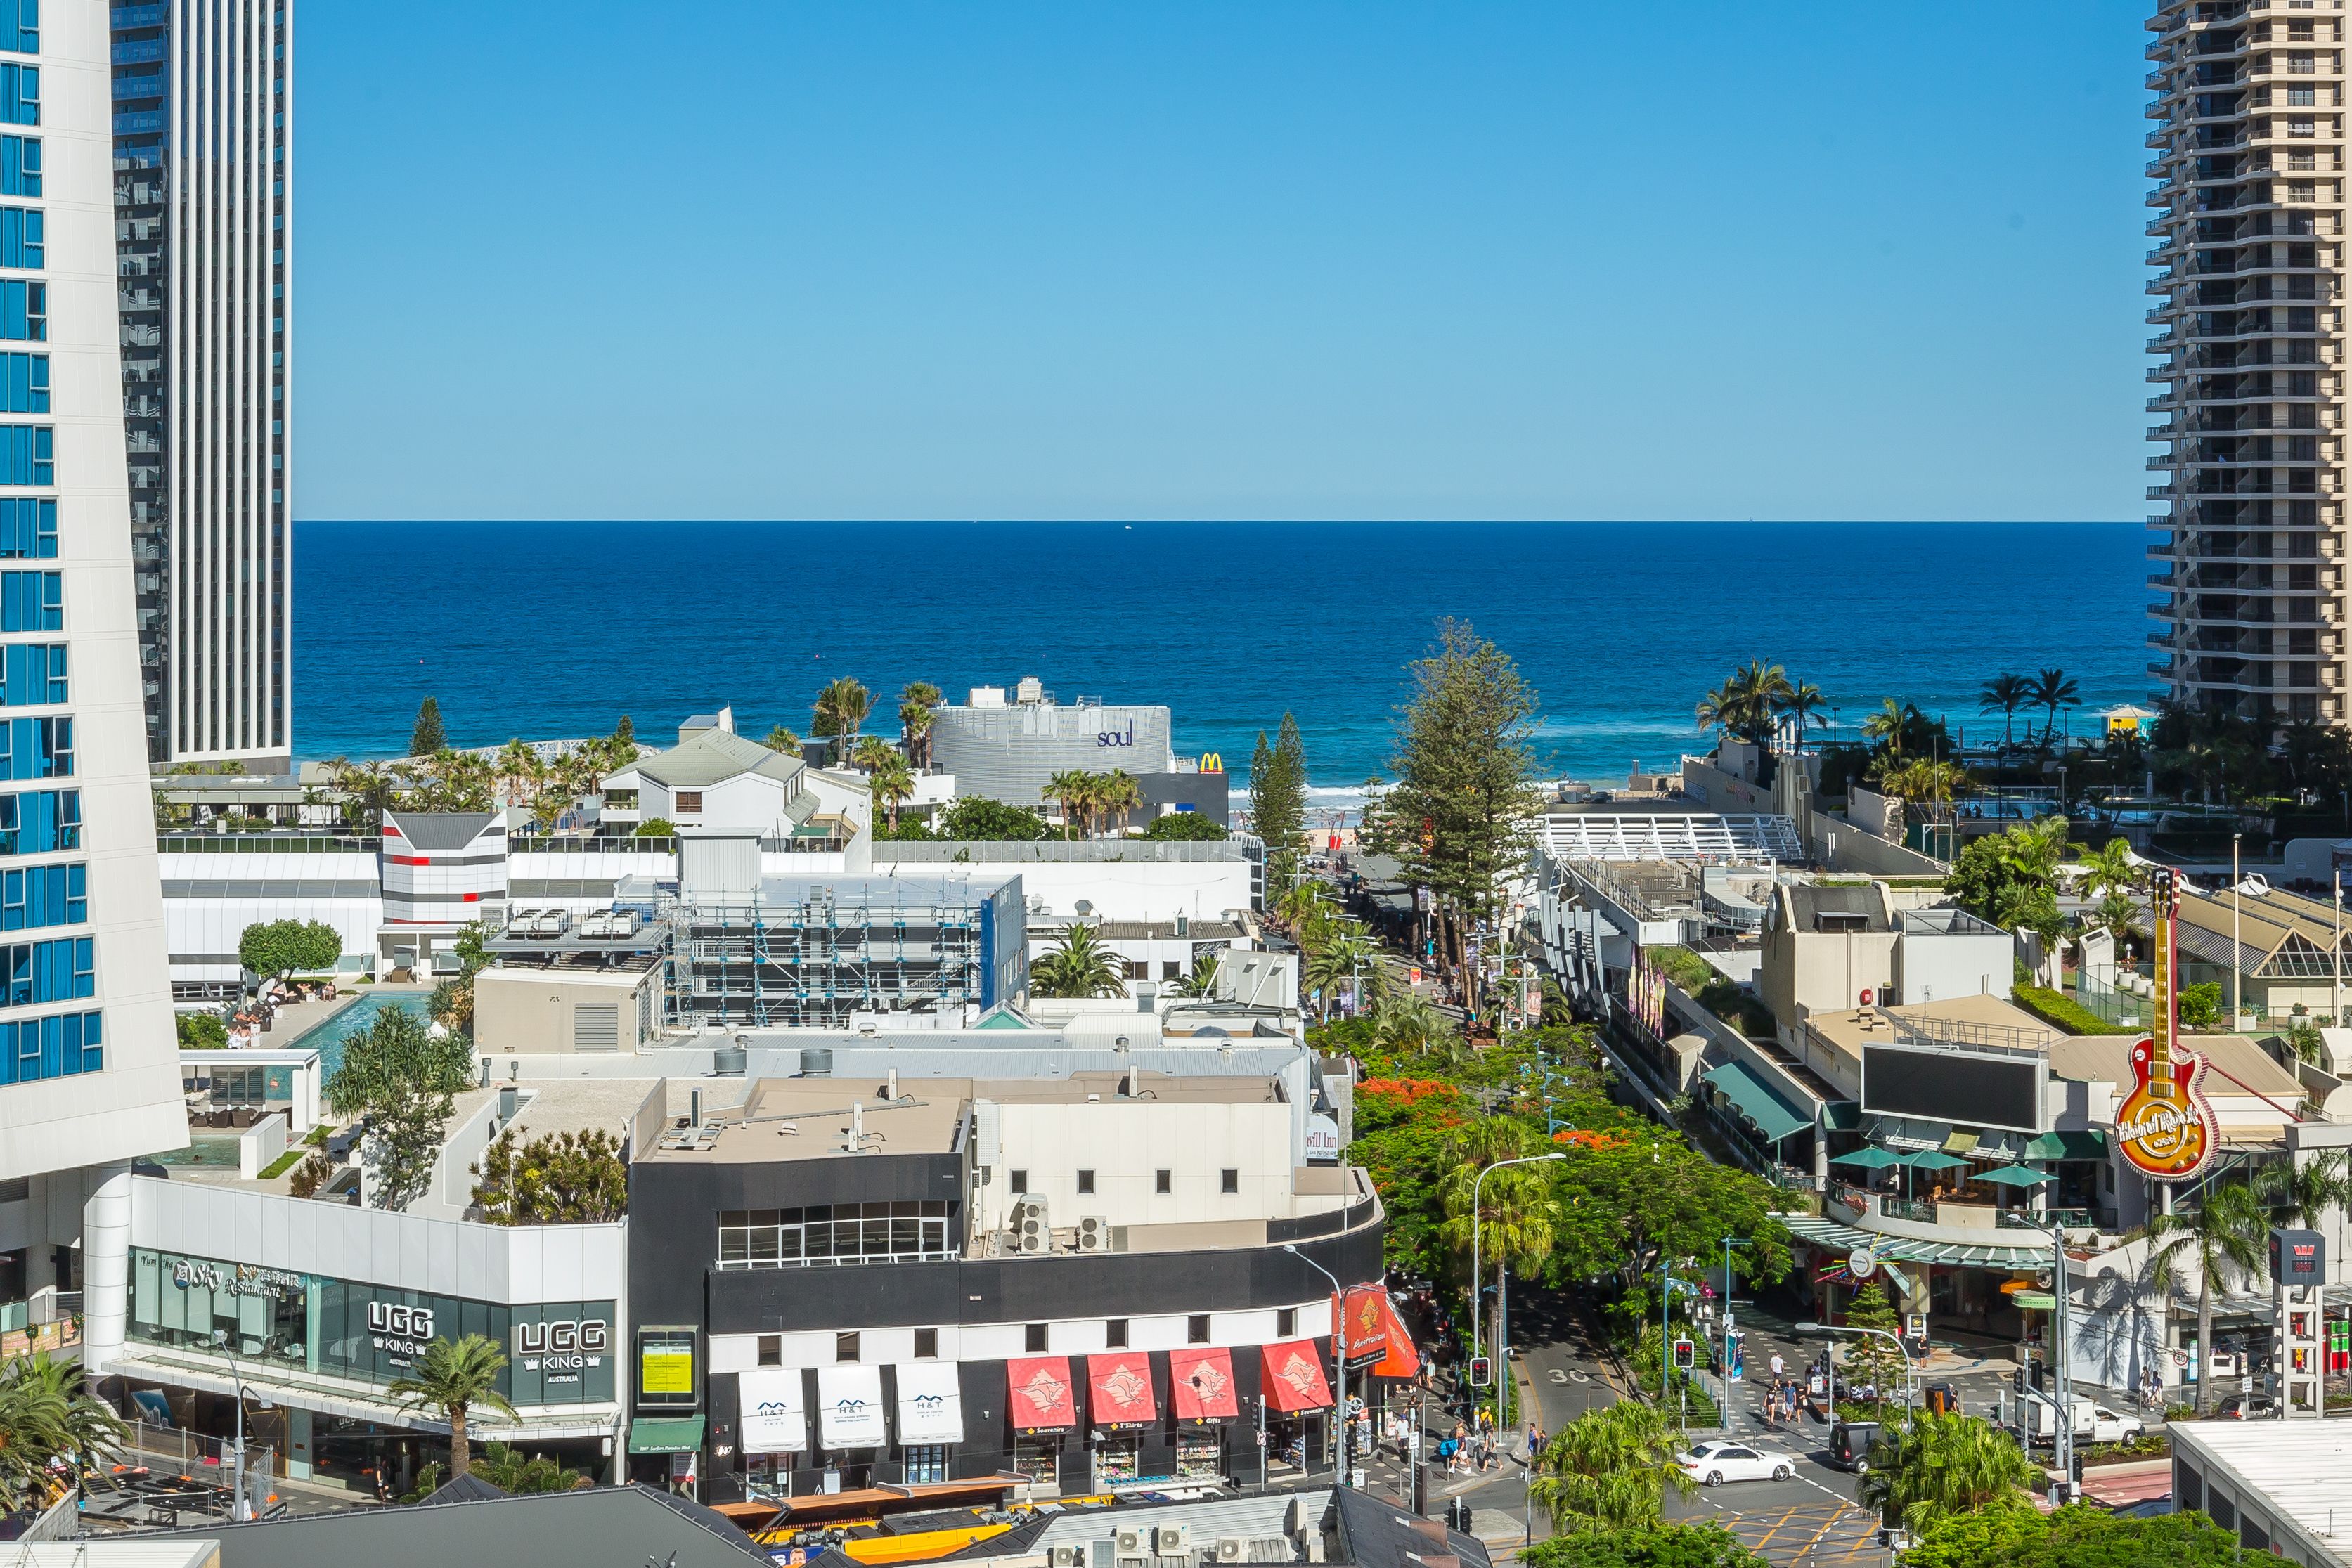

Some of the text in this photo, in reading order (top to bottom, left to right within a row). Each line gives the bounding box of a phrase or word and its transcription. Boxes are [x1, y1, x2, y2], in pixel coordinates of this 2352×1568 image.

[1097, 713, 1132, 747] soul
[2159, 1103, 2202, 1134] Rock
[368, 1301, 434, 1339] UGG
[385, 1338, 414, 1355] KING
[519, 1320, 607, 1354] UGG
[543, 1356, 583, 1370] KING
[548, 1375, 579, 1384] AUSTRALIA
